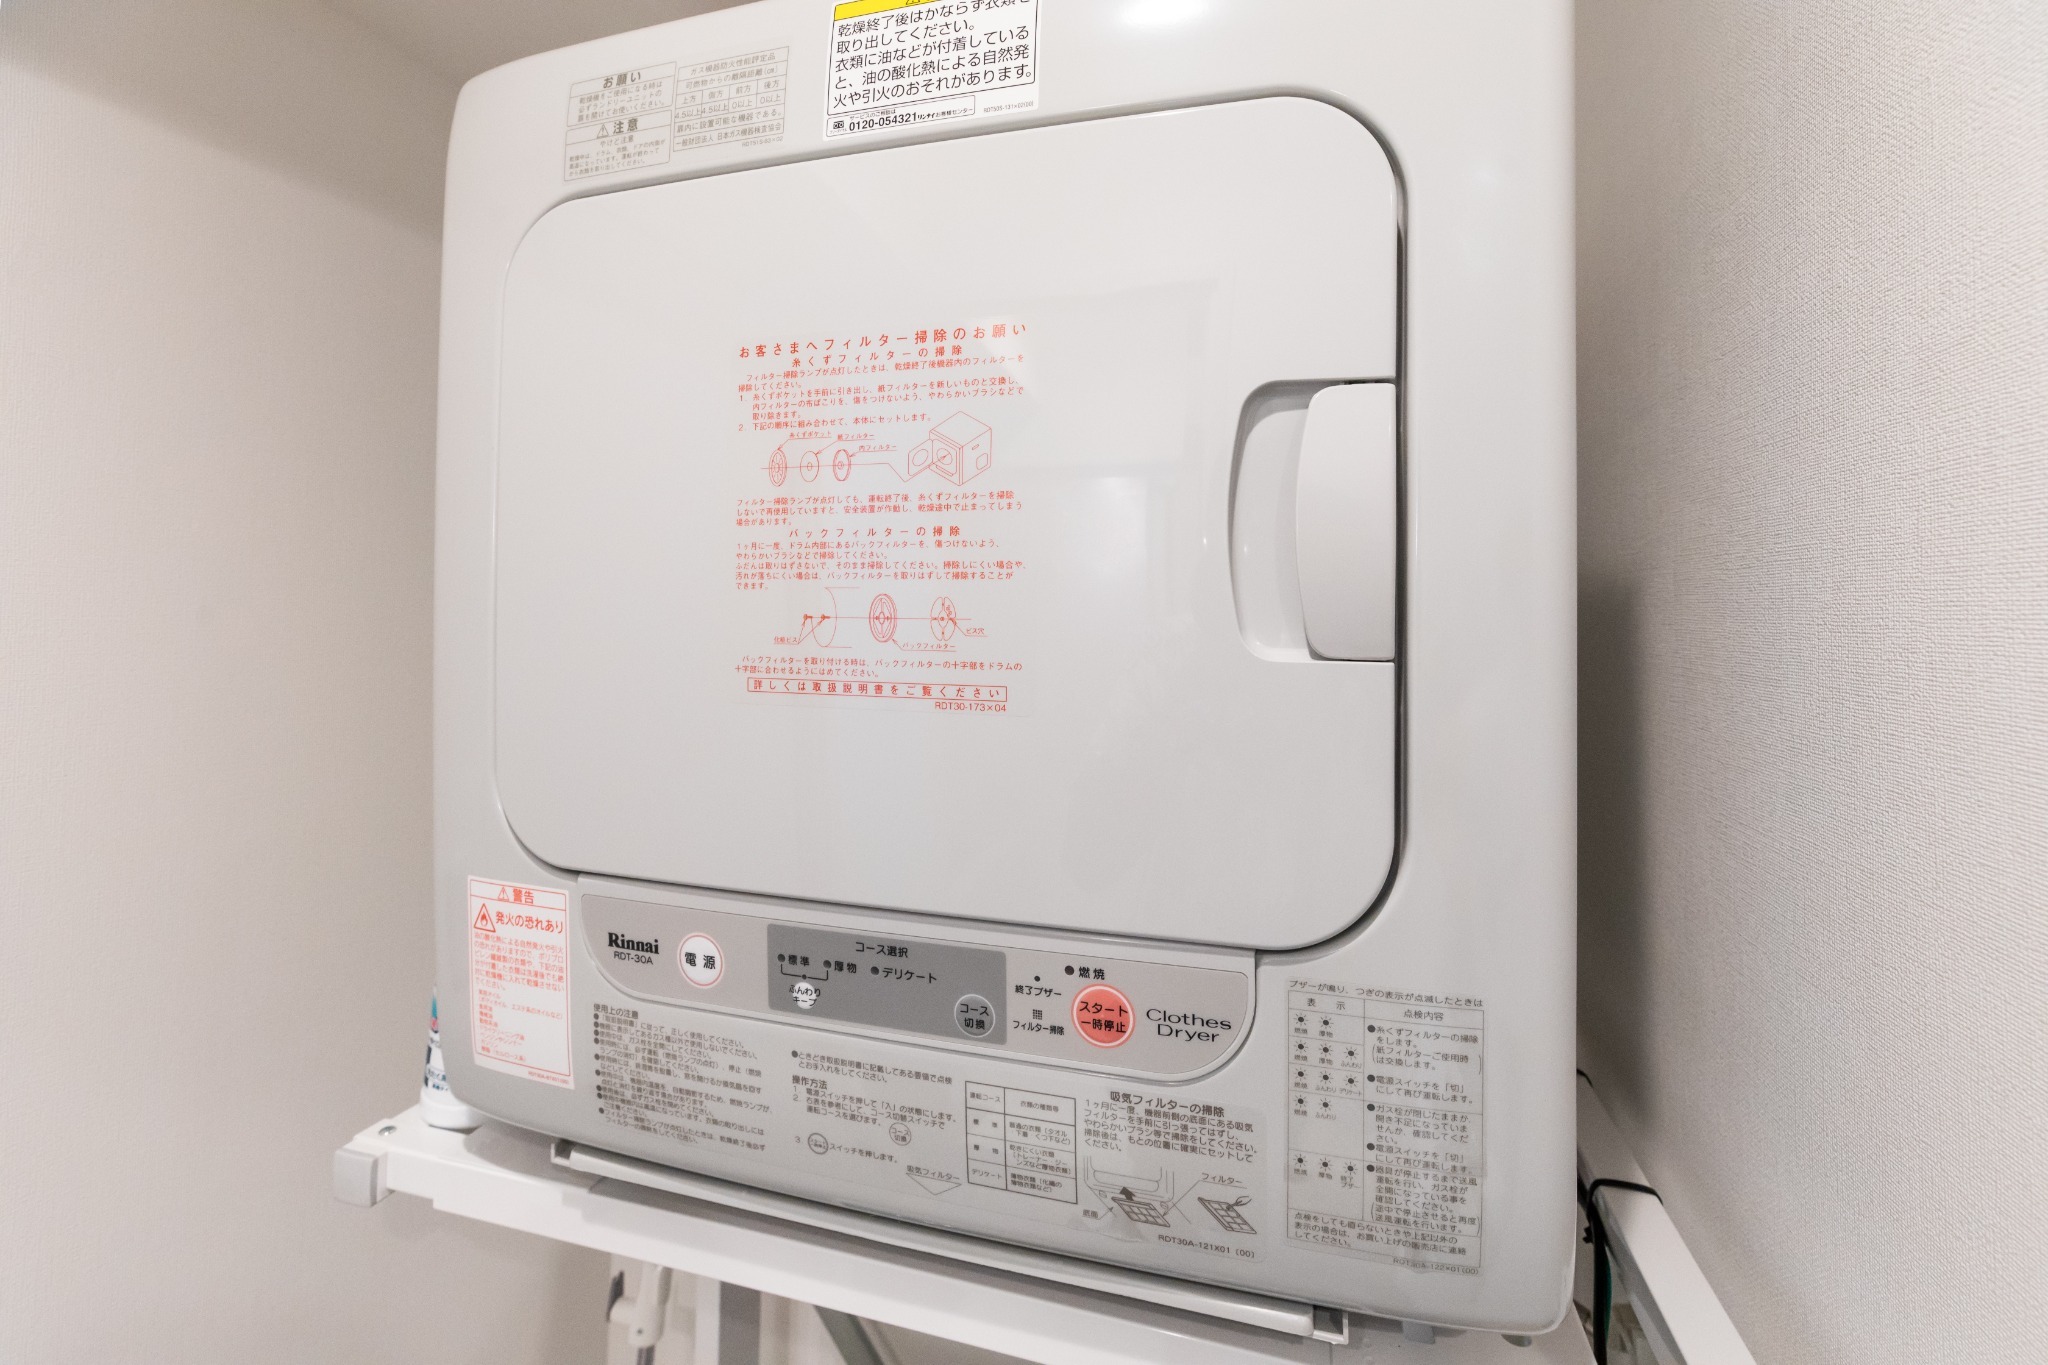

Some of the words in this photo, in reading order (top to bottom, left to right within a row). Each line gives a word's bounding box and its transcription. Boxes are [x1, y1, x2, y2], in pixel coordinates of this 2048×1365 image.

[837, 19, 975, 54] 取り出してください。
[835, 25, 1029, 72] 衣類に油などが付着している
[835, 44, 1029, 90] と、油の酸化熱による自然発
[603, 72, 641, 88] お願い
[736, 85, 751, 94] 前方
[764, 80, 779, 89] 後方
[833, 64, 1032, 109] 火や引火のおそれがあります。
[613, 118, 638, 134] 注意
[849, 112, 917, 131] 0120-054321
[740, 323, 1026, 359] お客さまへフィルター掃除のお願い
[792, 345, 962, 368] 糸くずフィルターの掃除
[739, 381, 802, 393] 掃除してください。
[752, 411, 801, 420] 取り除きます。
[736, 518, 792, 526] 場合があります。
[790, 526, 960, 538] バックフィルターの掃除
[736, 550, 888, 560] やわらかいブラシなどで掃除してください。
[736, 582, 768, 590] できます。
[902, 642, 956, 650] バックフィルター
[735, 665, 879, 678] 十字部に合わせるようにはめてください。
[753, 680, 999, 698] 詳しくは取扱説明書をご覧ください
[513, 888, 534, 904] 警告
[496, 911, 563, 933] 発火の恐れあり
[608, 933, 659, 954] Rinnai
[855, 942, 908, 958] コース選択
[614, 951, 653, 965] RDT-30A
[685, 952, 715, 969] 電源
[788, 955, 809, 966] 標準
[834, 960, 857, 973] 厚物
[882, 968, 936, 984] デリケート
[1079, 967, 1105, 980] 燃焼
[789, 984, 821, 997] ふんわり
[1015, 985, 1062, 997] 終了ブザー
[1290, 980, 1483, 1007] ブザーが鳴り、つぎの表示が点滅したときは
[793, 997, 817, 1006] キープ
[960, 1003, 989, 1016] コース
[1079, 1001, 1128, 1017] スタート
[594, 1004, 638, 1019] 使用上の注意
[1146, 1009, 1231, 1030] Clothes
[1404, 1010, 1443, 1021] 点検内容
[964, 1018, 985, 1030] 切換
[1012, 1021, 1064, 1035] フィルター掃除
[1081, 1020, 1126, 1033] 一時停止
[1157, 1024, 1219, 1042] Dryer
[1376, 1027, 1478, 1044] 糸くずフィルターの掃除
[1377, 1037, 1418, 1048] をします。
[799, 1061, 887, 1083] とお手入れをしてください。
[792, 1075, 827, 1090] 操作方法
[1376, 1087, 1473, 1104] にして再び運転します。
[1110, 1091, 1224, 1117] 吸気フィルターの掃除
[1085, 1109, 1240, 1141] フィルターを手前に引っ張ってはずし、
[1084, 1119, 1257, 1153] やわらかいブラシ等で掃除をしてください。
[1376, 1135, 1398, 1144] さい。
[1084, 1128, 1252, 1162] 掃除後は、もとの位置に確実にセットして
[1085, 1139, 1121, 1151] ください。
[830, 1144, 898, 1163] スイッチを押します。
[907, 1165, 960, 1180] 吸気フィルター
[1202, 1173, 1242, 1184] フィルター
[1295, 1232, 1350, 1246] してください。
